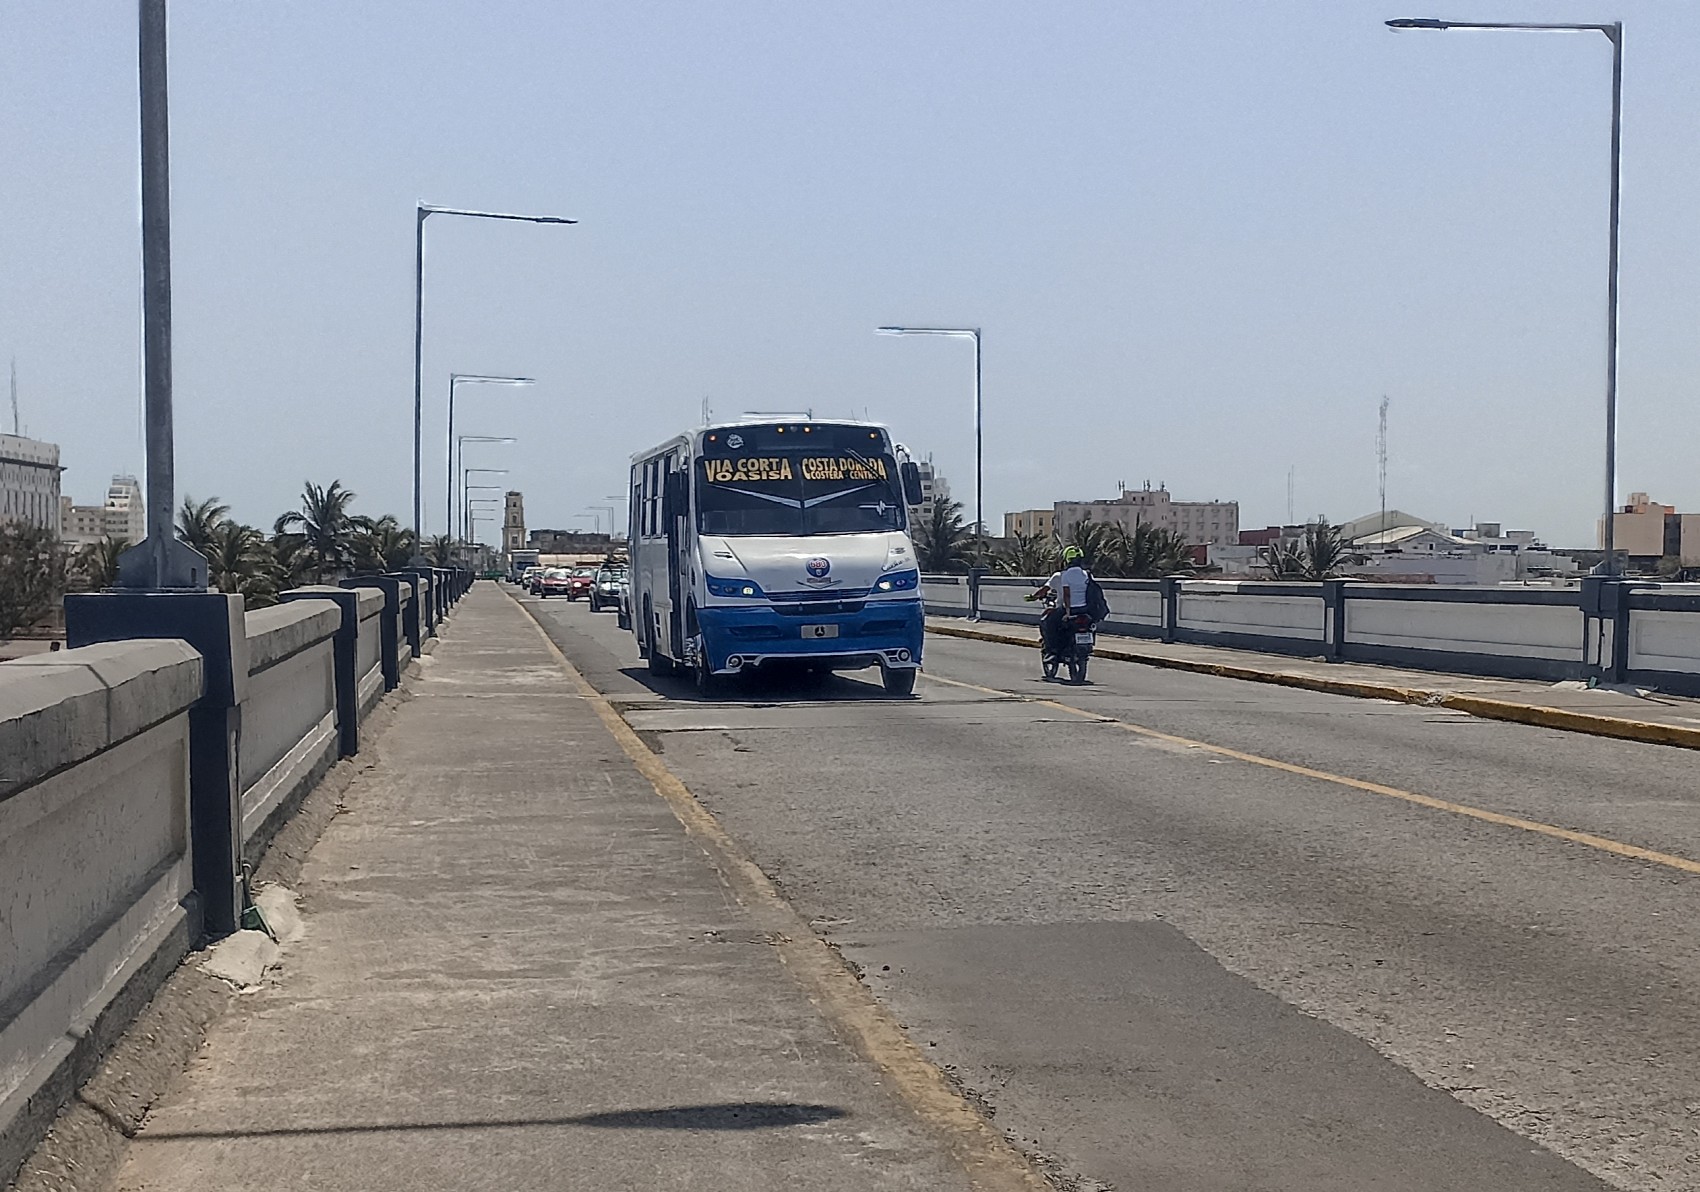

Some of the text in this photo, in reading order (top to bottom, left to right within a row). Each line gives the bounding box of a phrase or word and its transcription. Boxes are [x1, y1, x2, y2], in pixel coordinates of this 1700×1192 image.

[704, 458, 793, 482] VIA CORTA
[715, 470, 781, 482] OASIS
[802, 457, 838, 480] COSTA
[811, 470, 880, 480] COSTERA CENTR
